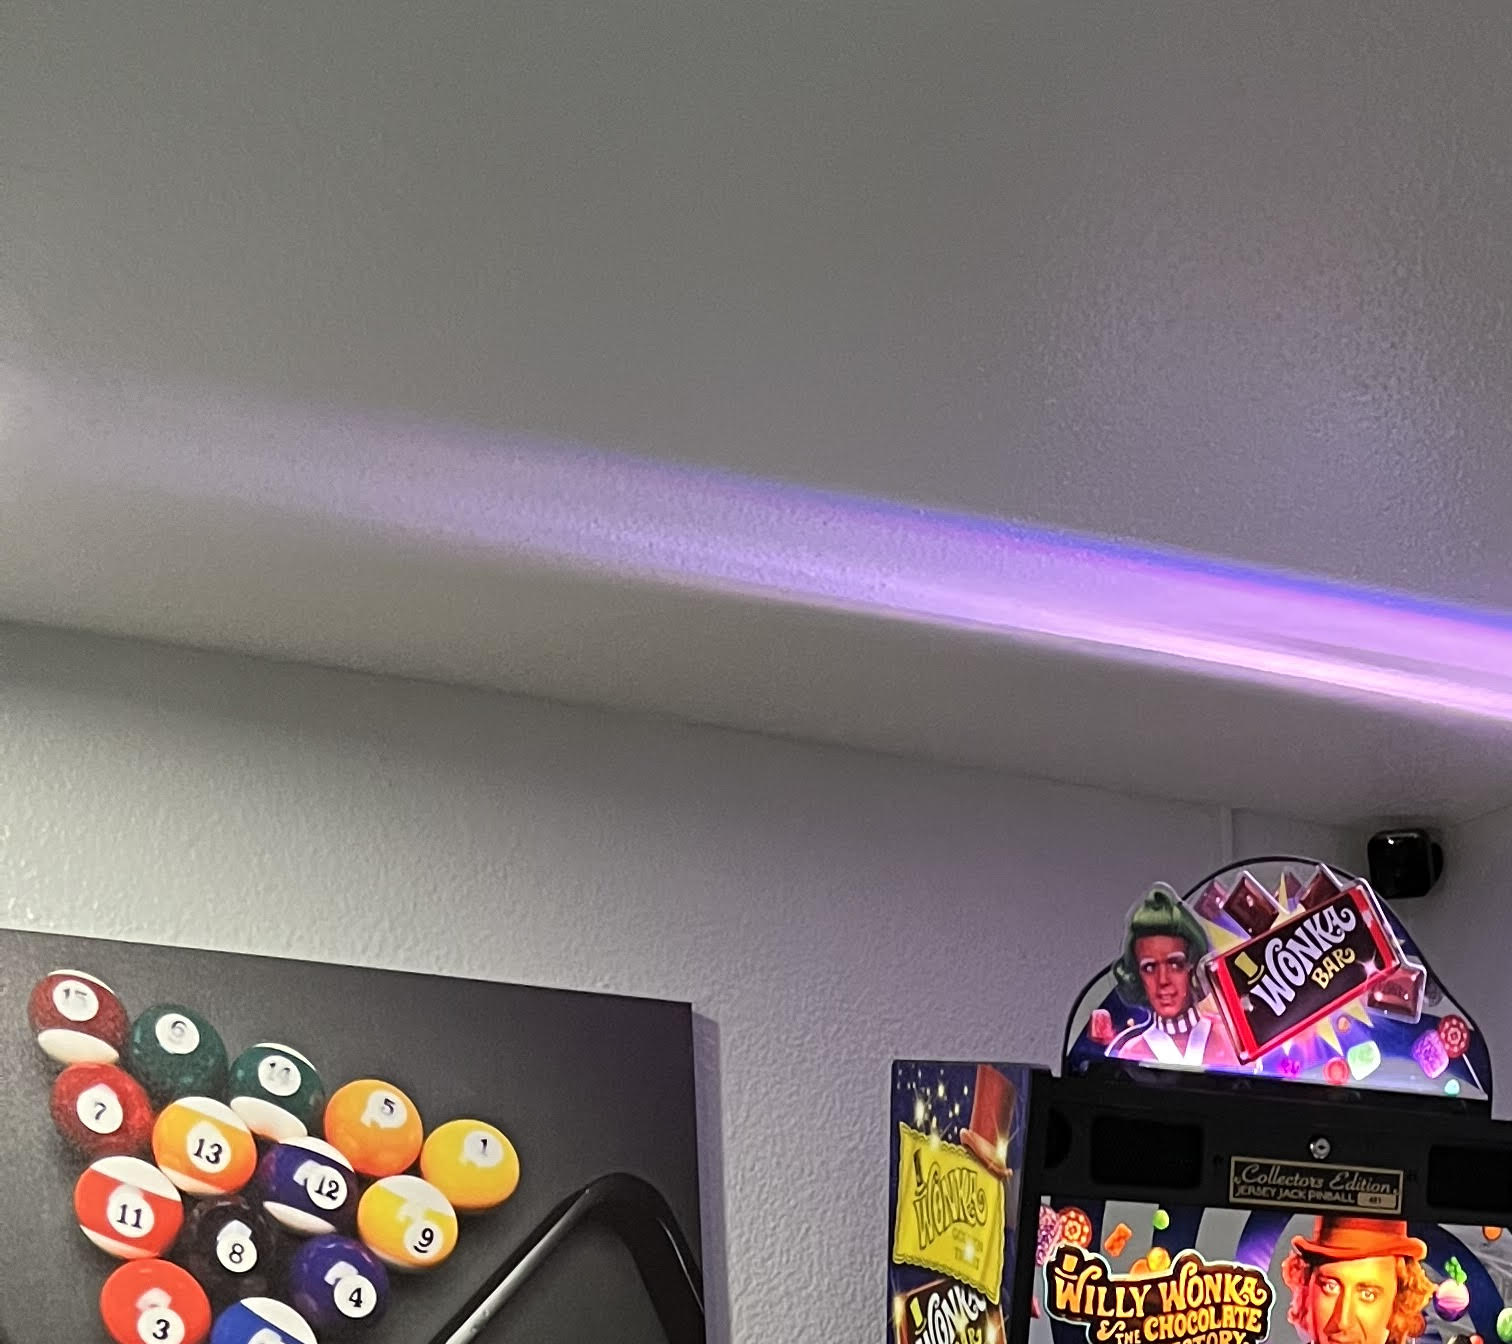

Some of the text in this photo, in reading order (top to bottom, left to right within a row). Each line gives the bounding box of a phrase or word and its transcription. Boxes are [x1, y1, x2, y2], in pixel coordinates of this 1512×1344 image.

[1250, 905, 1357, 1017] WONKA
[1311, 947, 1356, 990] BAR
[171, 1019, 187, 1039] 6
[94, 1102, 107, 1121] 7
[383, 1098, 396, 1116] 5
[193, 1137, 224, 1165] 13
[479, 1138, 489, 1157] 1
[314, 1174, 340, 1201] 12
[1241, 1163, 1391, 1194] Collectors Edition
[913, 1161, 988, 1250] WONKA
[1235, 1184, 1277, 1198] JERSEY
[1278, 1187, 1307, 1201] JACK
[1307, 1190, 1356, 1204] PINBALL
[116, 1203, 143, 1230] 11
[416, 1226, 435, 1250] 9
[228, 1242, 245, 1264] 8
[348, 1286, 363, 1308] 4
[1054, 1260, 1268, 1318] WILLY WONKA
[152, 1318, 171, 1340] 3
[1096, 1319, 1127, 1341] &
[1143, 1304, 1262, 1342] CHOCOLATE
